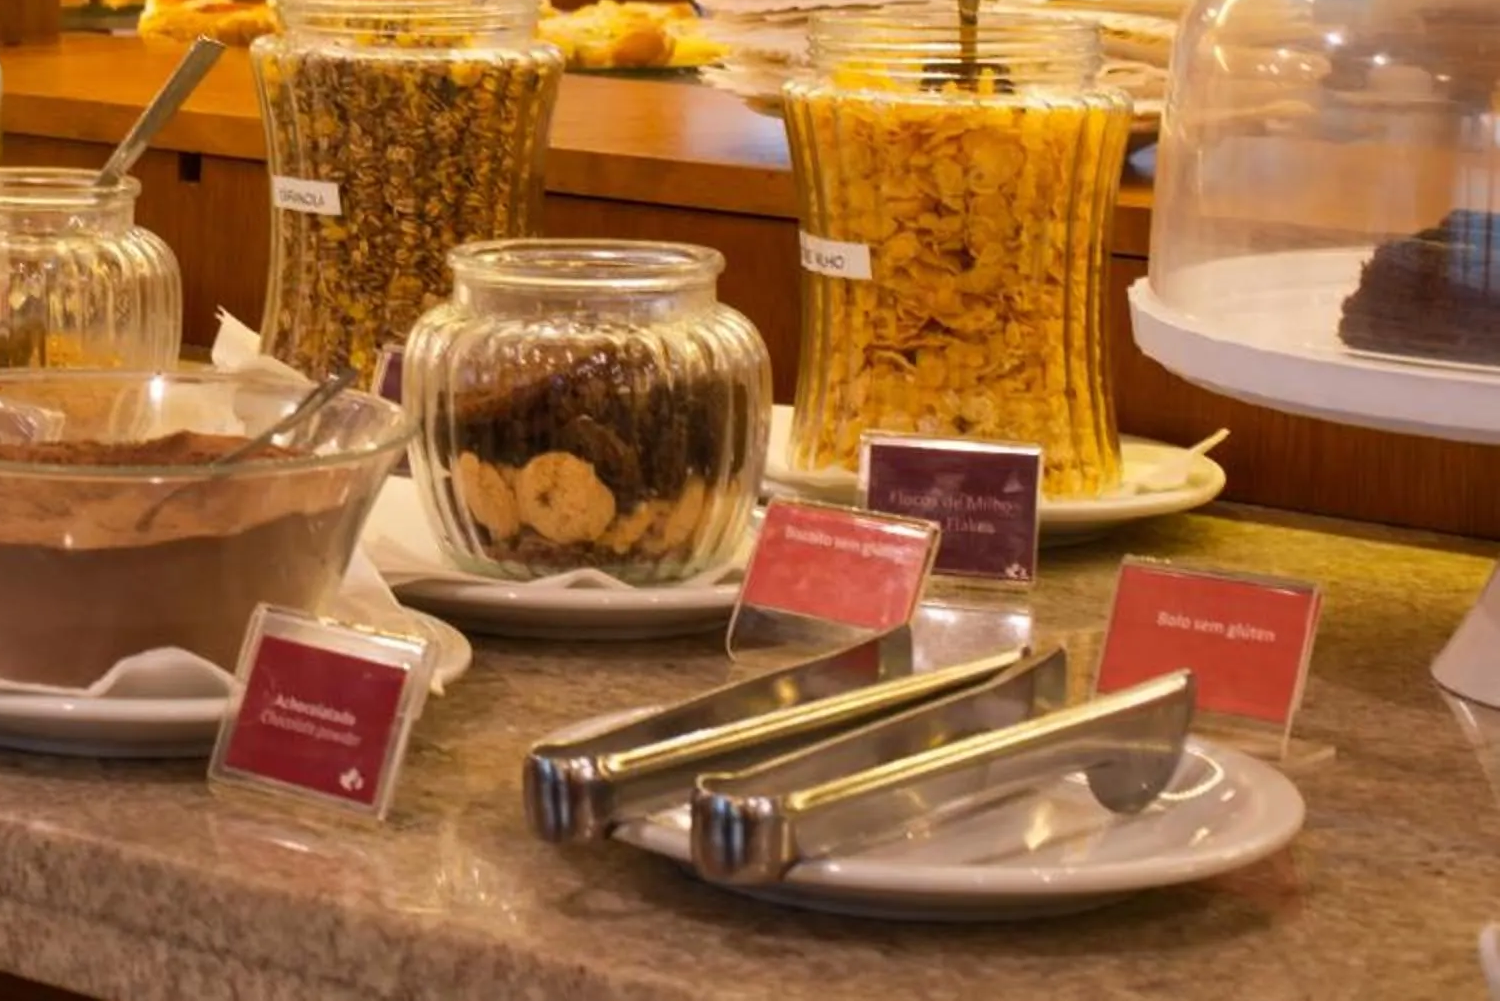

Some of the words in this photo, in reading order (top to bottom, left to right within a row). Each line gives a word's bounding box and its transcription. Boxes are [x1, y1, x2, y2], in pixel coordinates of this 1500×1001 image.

[1157, 611, 1191, 629] Bolo
[1193, 617, 1225, 634] sem
[1227, 622, 1276, 643] glúten
